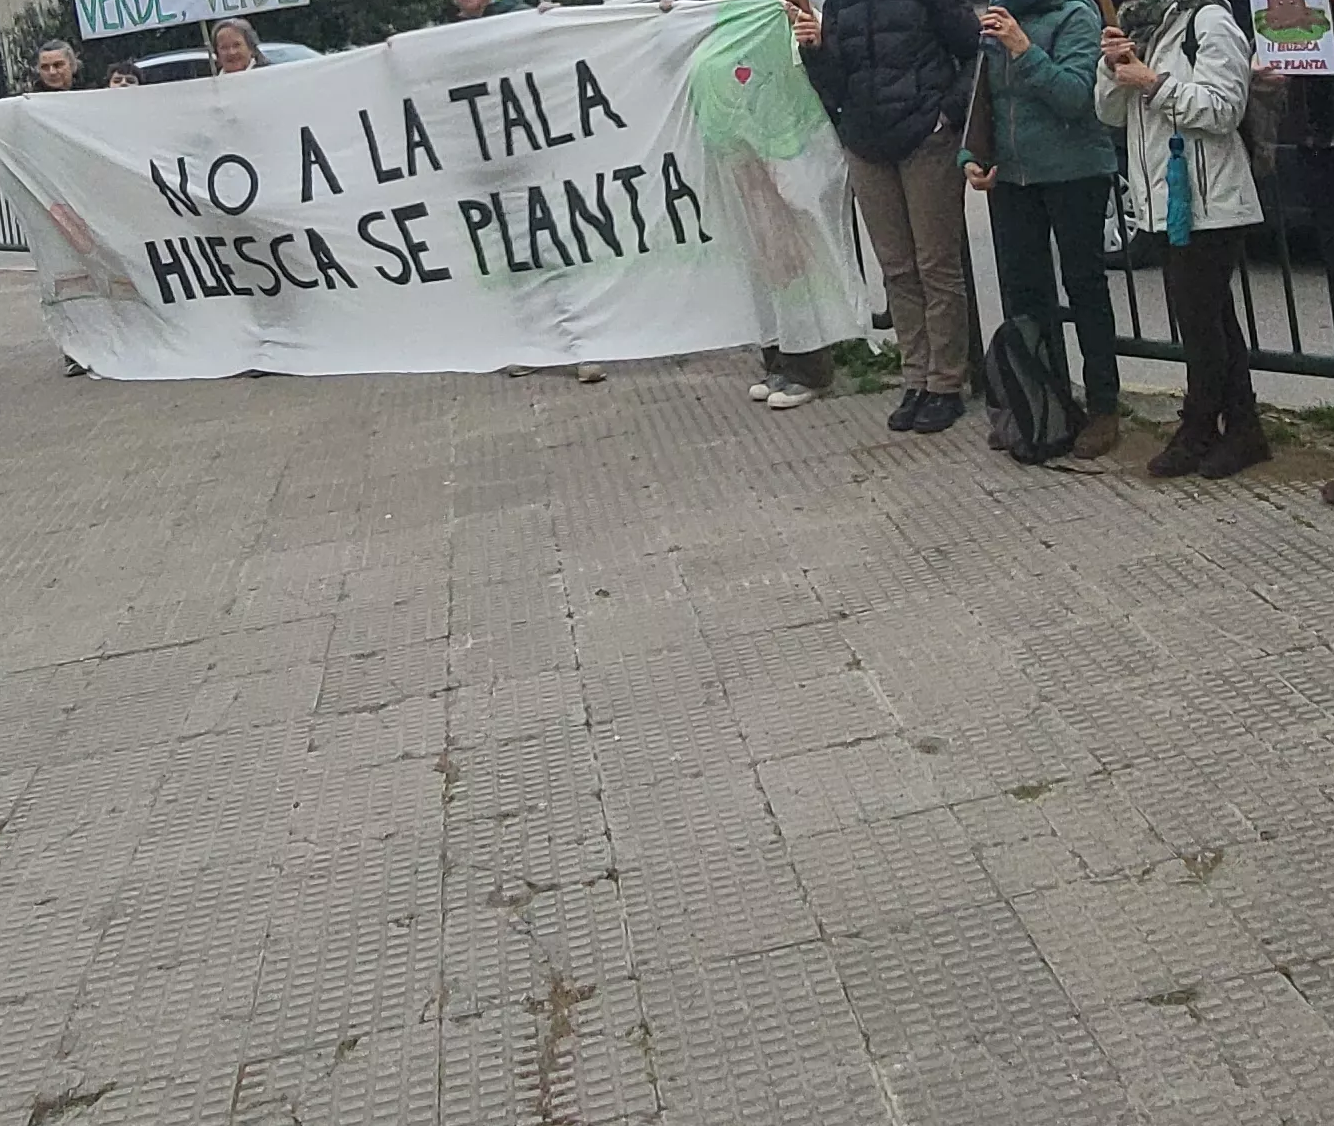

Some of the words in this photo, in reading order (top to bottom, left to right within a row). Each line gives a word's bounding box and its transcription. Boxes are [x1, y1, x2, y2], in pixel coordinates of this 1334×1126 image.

[150, 153, 259, 217] NO
[300, 125, 344, 203] A
[358, 97, 443, 184] LA
[449, 59, 627, 162] TALA
[1284, 59, 1328, 70] PLANTA
[145, 227, 359, 304] HUESCA
[357, 201, 452, 285] SE
[458, 150, 713, 276] PLANTA
